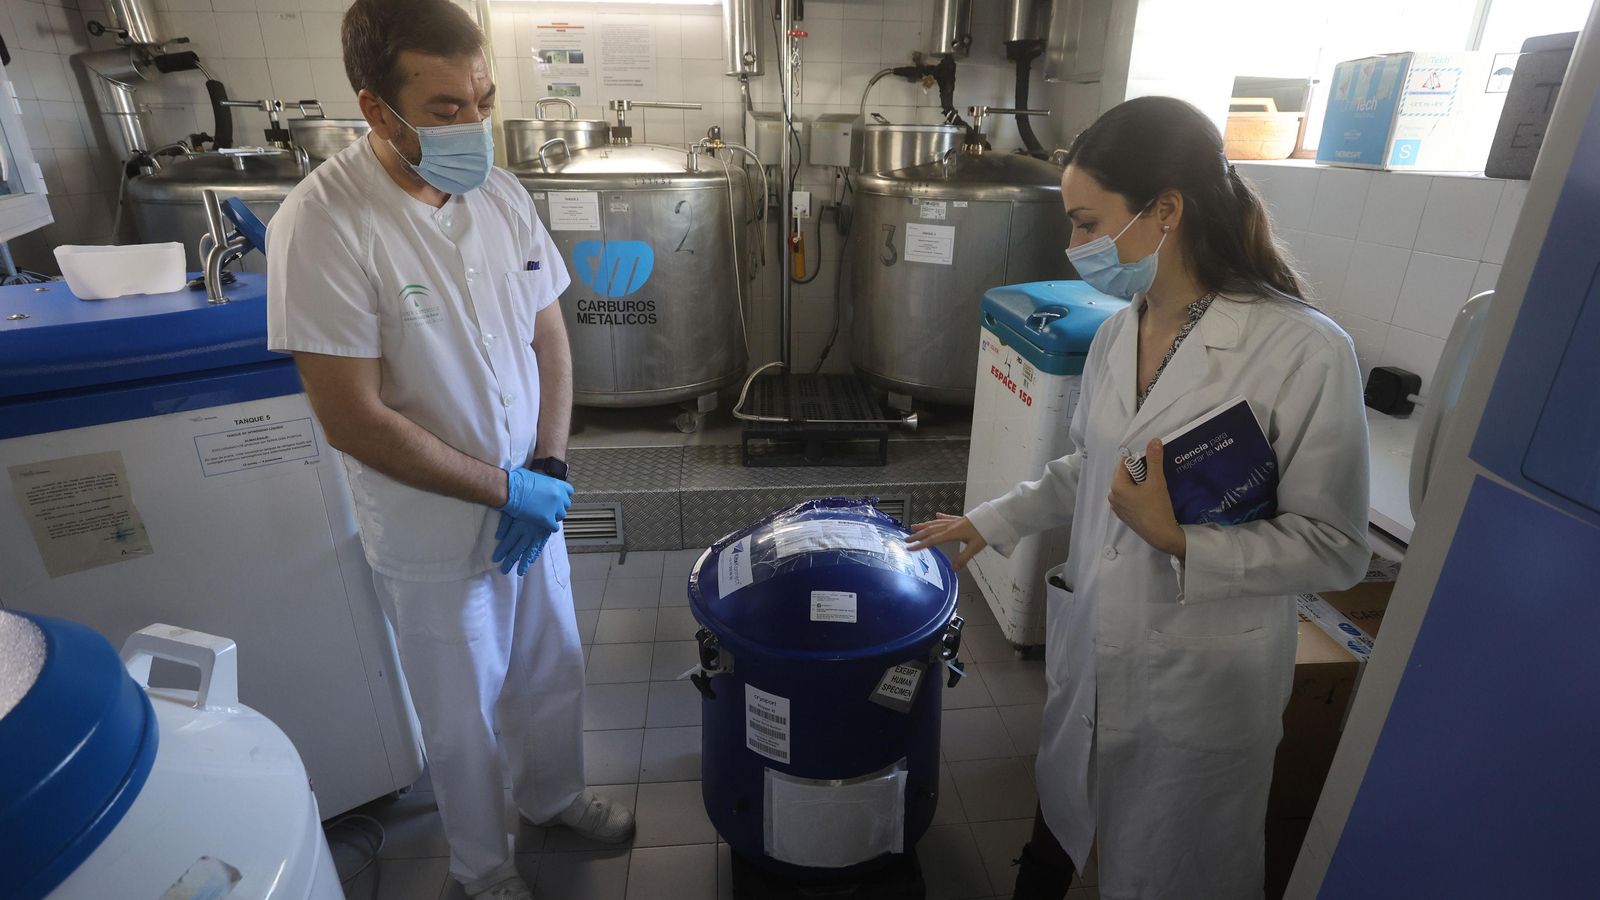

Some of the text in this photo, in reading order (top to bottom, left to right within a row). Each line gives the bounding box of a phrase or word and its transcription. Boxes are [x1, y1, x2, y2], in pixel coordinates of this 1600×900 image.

[1399, 143, 1412, 159] S
[674, 199, 695, 254] 2
[880, 223, 898, 267] 3
[577, 299, 656, 312] CARBUROS
[576, 312, 657, 325] METALICOS
[990, 364, 1017, 394] ESPACE
[1019, 389, 1033, 407] 150
[233, 415, 264, 426] TANQUE
[1175, 432, 1228, 464] Ciencia para
[1176, 437, 1234, 473] mejorar la vida
[894, 665, 918, 677] EXEMPT
[890, 674, 913, 687] HUMAN
[881, 683, 913, 697] SPECIMEN
